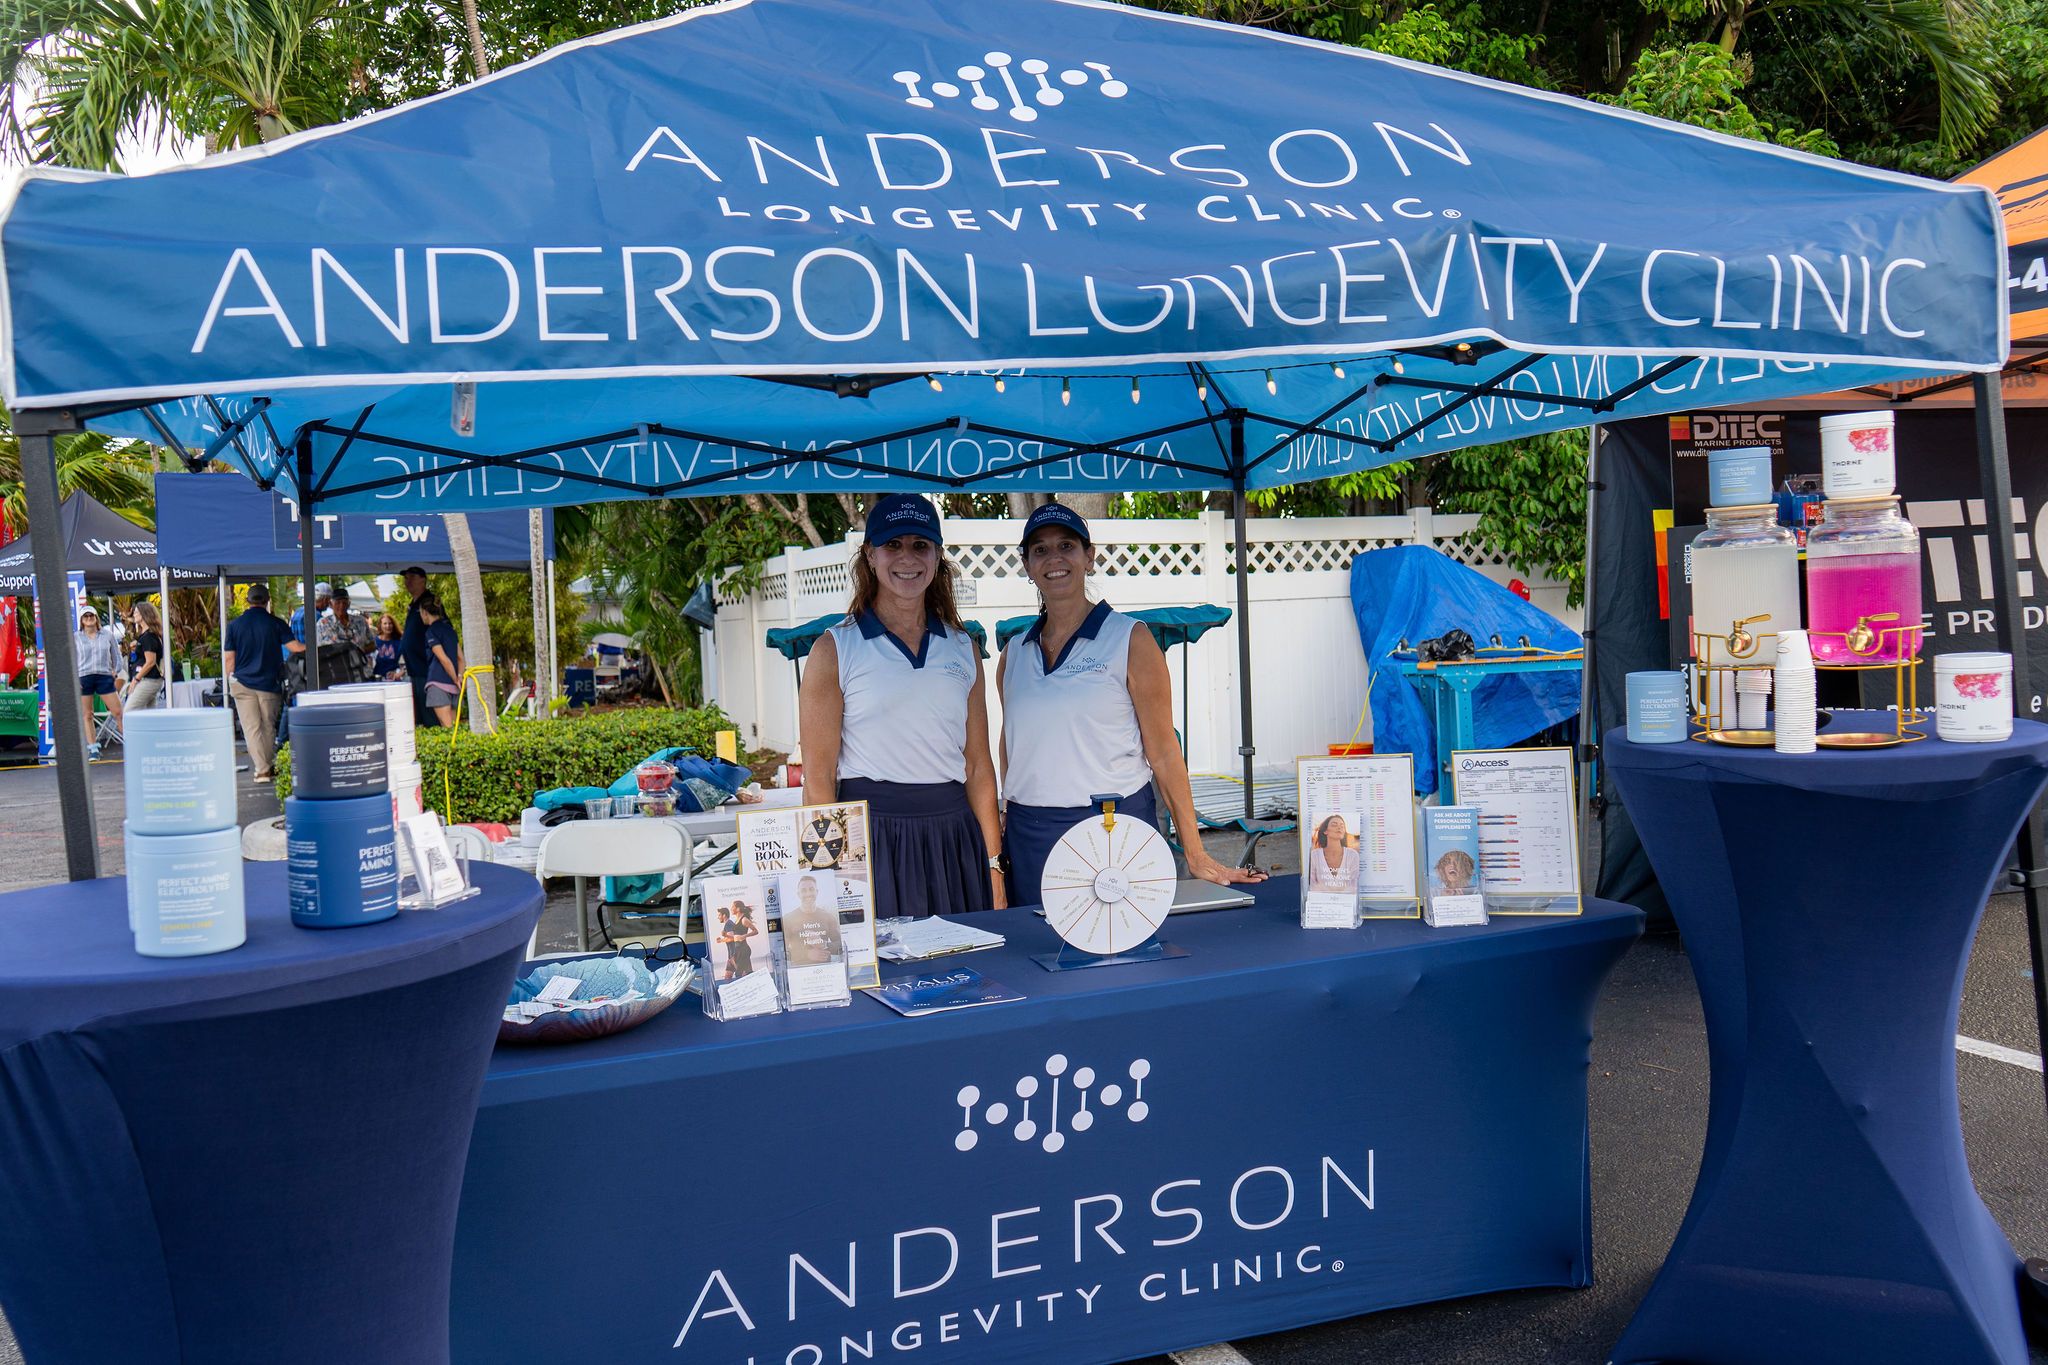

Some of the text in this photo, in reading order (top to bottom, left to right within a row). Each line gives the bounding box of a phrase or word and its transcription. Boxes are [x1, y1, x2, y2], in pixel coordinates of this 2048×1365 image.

[626, 121, 1472, 190] ANDERSON
[717, 196, 1148, 231] LONGEVITY
[191, 245, 979, 353] ANDERSON
[1641, 249, 1926, 338] CLINIC
[1832, 459, 1863, 467] THORNE
[113, 567, 158, 582] Florida
[1939, 703, 1966, 711] THORNE
[329, 742, 385, 755] PERFECT AMINO
[329, 752, 370, 762] CREATINE
[750, 824, 791, 834] ANDERSON
[754, 840, 785, 851] SPIN.
[755, 850, 792, 861] BOOK.
[359, 855, 393, 872] AMINO
[756, 861, 787, 871] WIN.
[800, 930, 826, 938] Hormone
[880, 973, 970, 992] VITALIS
[673, 1150, 1376, 1348] ANDERSON
[747, 1284, 1102, 1365] ONGEVITY
